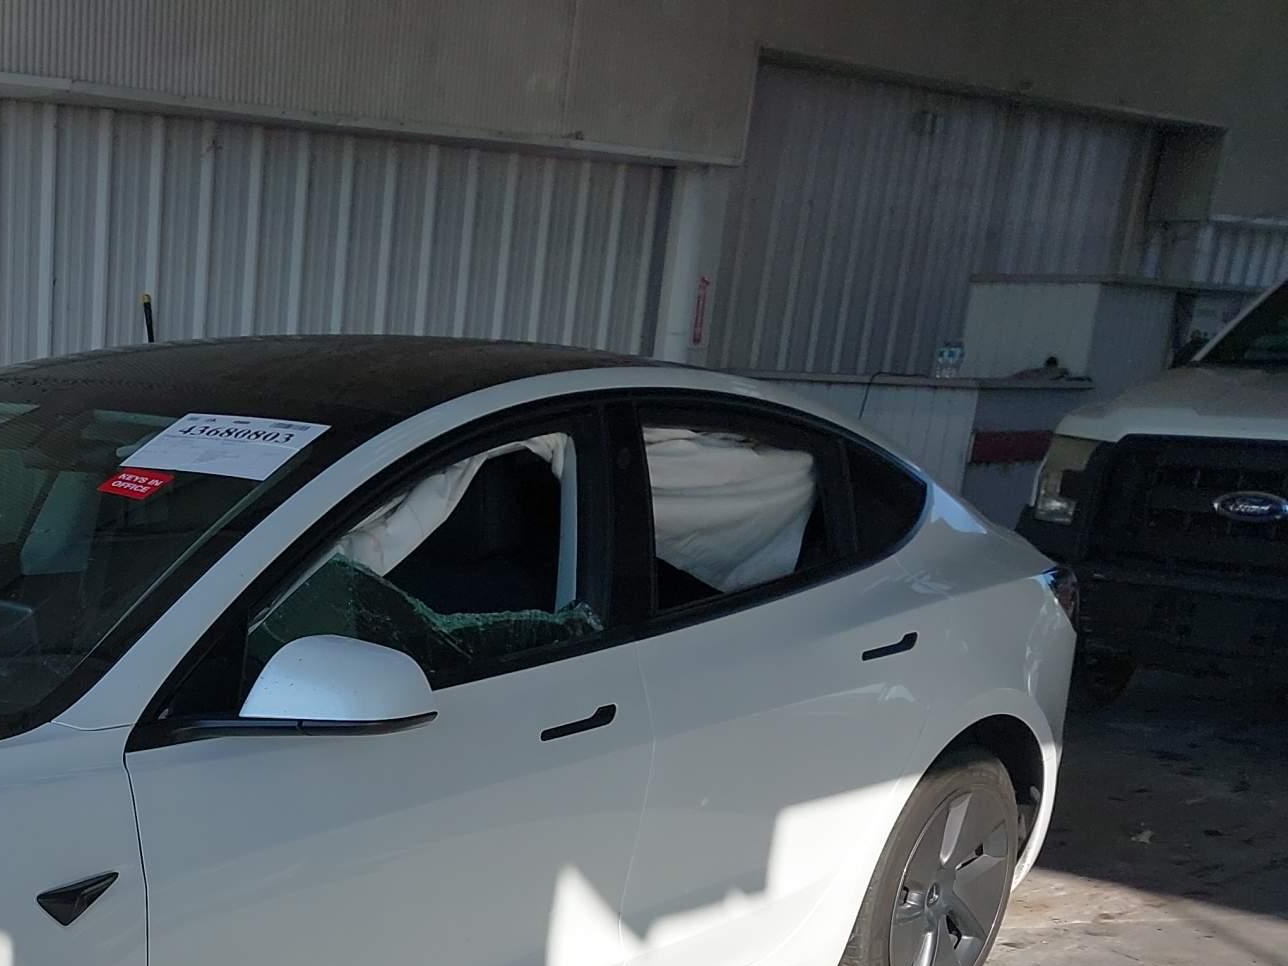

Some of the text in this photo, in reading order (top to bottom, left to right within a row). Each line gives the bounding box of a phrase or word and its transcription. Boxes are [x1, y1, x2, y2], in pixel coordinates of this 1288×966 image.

[179, 426, 295, 443] 43680803
[112, 480, 151, 493] OFFICE
[118, 473, 164, 487] KEYS IN
